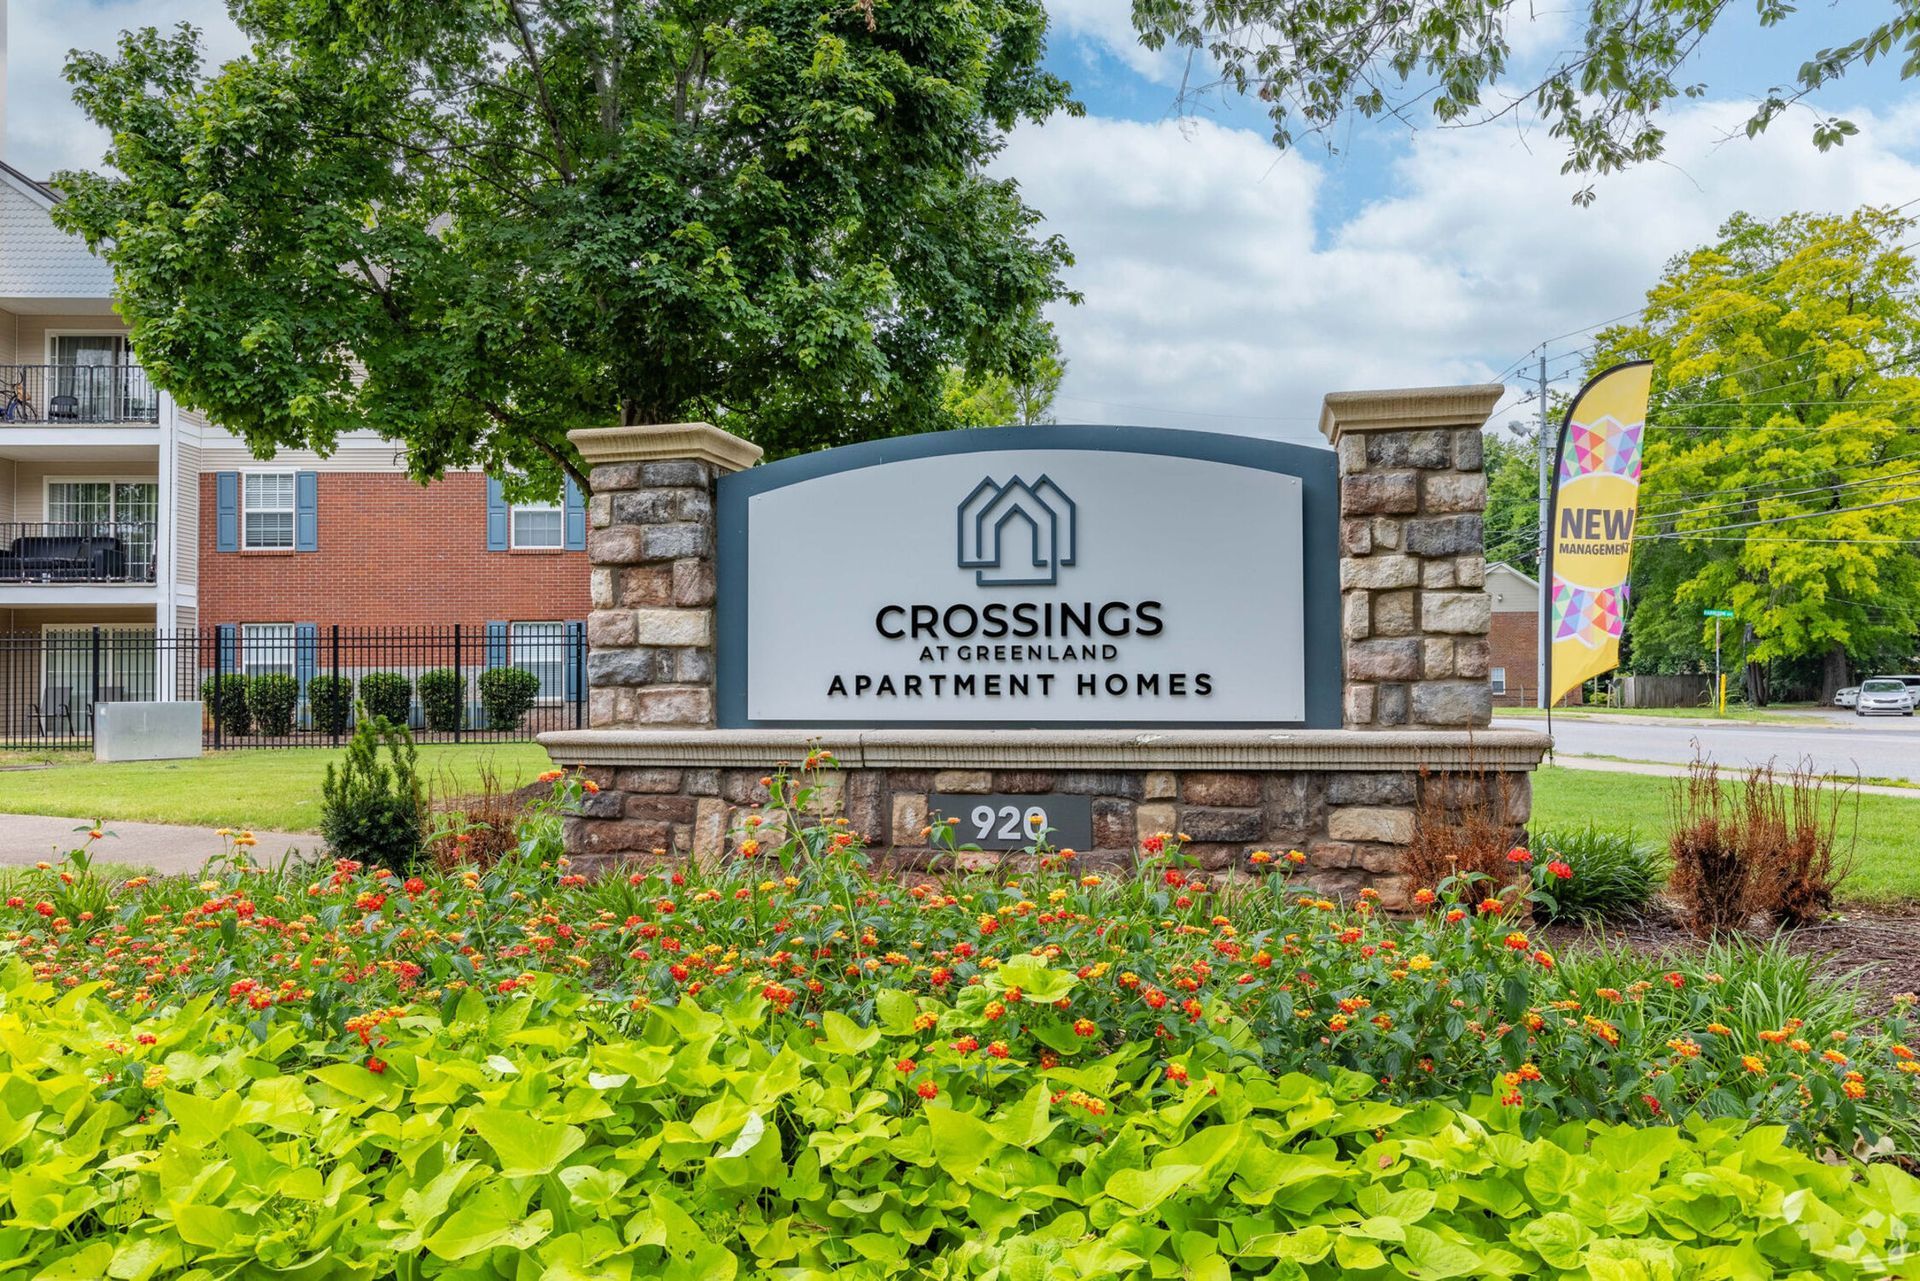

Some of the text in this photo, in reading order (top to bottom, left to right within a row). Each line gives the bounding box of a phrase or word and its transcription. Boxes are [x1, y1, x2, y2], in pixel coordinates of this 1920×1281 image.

[1561, 508, 1634, 540] NEW
[876, 601, 1163, 639] CROSSINGS
[919, 644, 1118, 662] AT GREENLAND
[827, 673, 1213, 696] APARTMENT HOMES
[971, 805, 1048, 841] 920
